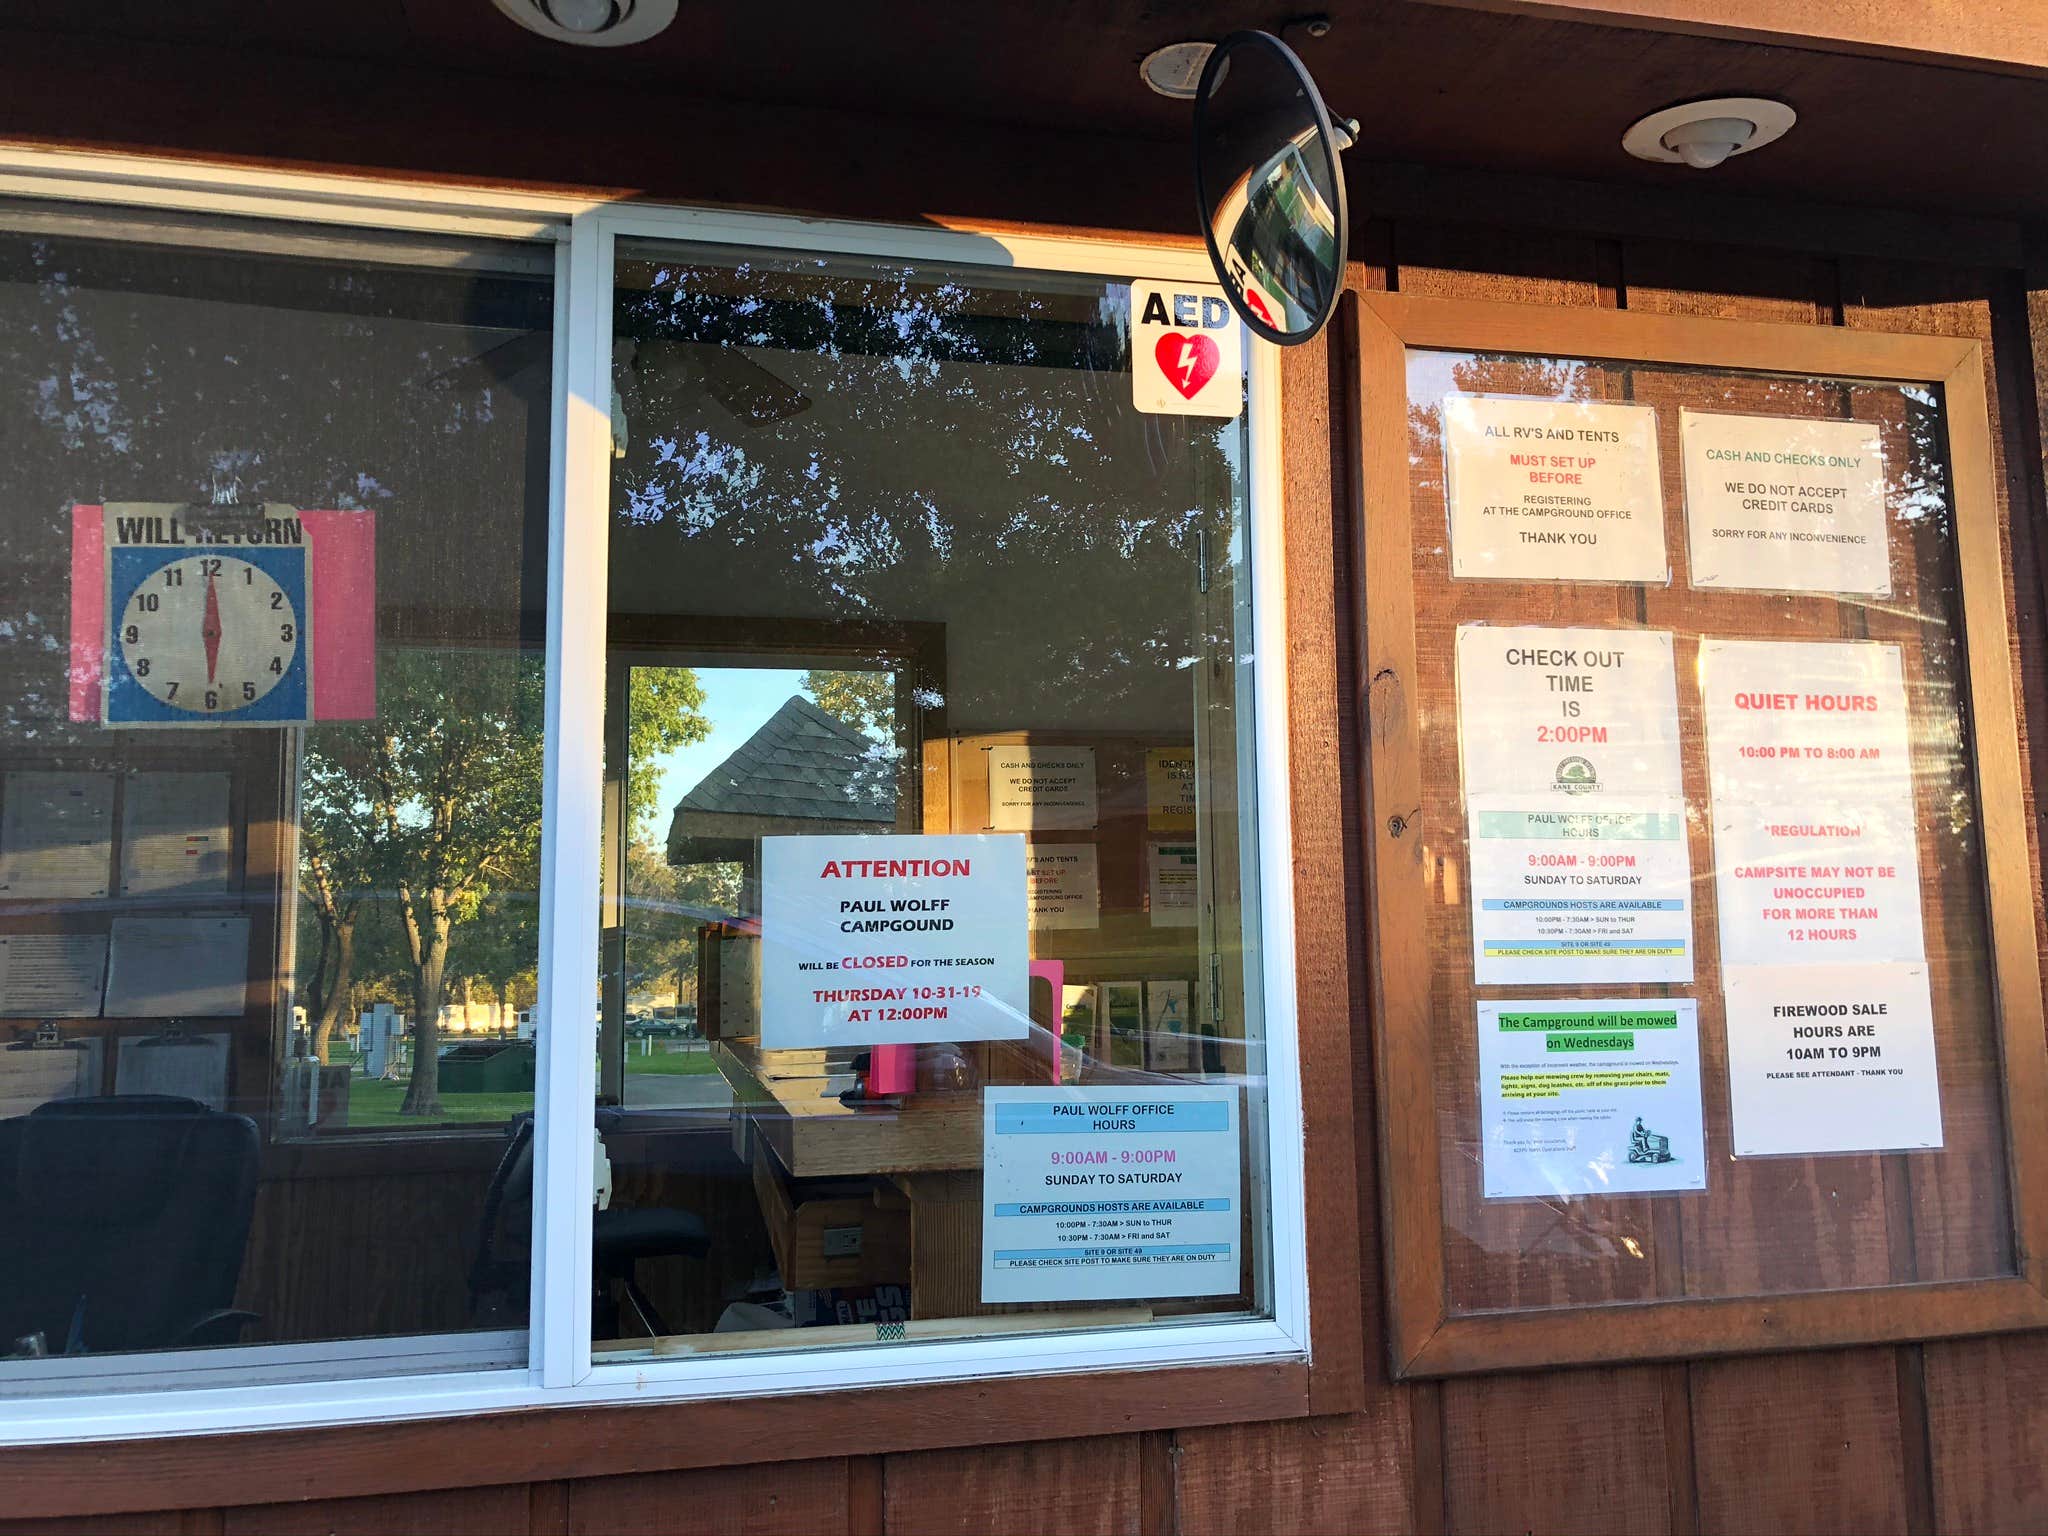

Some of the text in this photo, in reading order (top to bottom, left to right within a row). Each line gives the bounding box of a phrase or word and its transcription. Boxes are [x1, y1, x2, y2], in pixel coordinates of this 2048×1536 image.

[1141, 292, 1230, 329] AED
[1485, 425, 1619, 443] ALL RV'S AND TENTS
[1510, 454, 1596, 470] MUST SET UP
[1705, 449, 1861, 469] CASH AND CHECKS ONLY
[1529, 471, 1582, 485] BEFORE
[1725, 481, 1847, 499] WE DO NOT ACCEPT
[1523, 495, 1592, 506] REGISTERING
[1742, 498, 1833, 514] CREDIT CARDS
[1482, 506, 1632, 520] AT THE CAMPGROUND OFFICE
[116, 517, 185, 545] WILL
[1519, 531, 1597, 545] THANK YOU
[1711, 528, 1867, 545] SORRY FOR ANY INCONVENIENCE
[200, 559, 222, 577] 12
[164, 568, 183, 586] 11
[243, 568, 253, 585] 1
[135, 594, 159, 612] 10
[270, 592, 283, 610] 2
[125, 625, 139, 644] 9
[280, 623, 294, 643] 3
[269, 657, 283, 675] 4
[1506, 649, 1624, 668] CHECK OUT
[136, 658, 150, 677] 8
[166, 682, 180, 699] 7
[242, 682, 256, 701] 5
[1546, 675, 1594, 692] TIME
[205, 691, 217, 710] 6
[1734, 693, 1878, 712] QUIET HOURS
[1562, 701, 1581, 717] IS
[1537, 726, 1608, 743] 2:00PM
[1738, 747, 1880, 759] 10:00 PM TO 8:00 AM
[820, 859, 970, 878] ATTENTION
[1528, 855, 1636, 867] 9:00AM 9:00PM
[1524, 875, 1642, 885] SUNDAY TO SATURDAY
[1734, 866, 1896, 878] CAMPSITE MAY NOT BE
[1773, 887, 1865, 899] UNOCCUPIED
[840, 899, 950, 913] PAUL WOLFF
[1503, 901, 1662, 909] CAMPGROUNDS HOSTS ARE AVAILABLE
[1762, 908, 1878, 920] FOR MORE THAN
[840, 919, 954, 933] CAMPGOUND
[1787, 928, 1856, 941] 12 HOURS
[798, 955, 995, 971] WILL BE CLOSED FOR THE SEASON
[813, 986, 982, 1003] THURSDAY 10-31-19
[847, 1007, 948, 1022] AT 12:00PM
[1773, 1004, 1887, 1017] FIREWOOD SALE
[1499, 1013, 1677, 1030] The Campground will be mowed
[1793, 1025, 1875, 1038] HOURS ARE
[1546, 1037, 1634, 1050] on Wednesdays
[1786, 1046, 1881, 1060] 10AM TO 9PM
[1811, 1070, 1855, 1078] ATTENDANT
[1053, 1104, 1175, 1116] PAUL WOLFF OFFICE
[1093, 1119, 1136, 1131] HOURS
[1051, 1150, 1176, 1165] 9:00AM 9:00PM
[1045, 1172, 1183, 1186] SUNDAY TO SATURDAY
[1019, 1201, 1205, 1214] CAMPGROUNDS HOSTS ARE AVAILABLE
[1125, 1219, 1142, 1227] SUN
[1143, 1219, 1150, 1227] to
[1151, 1219, 1172, 1227] THUR
[1127, 1232, 1140, 1240] FRI
[1140, 1232, 1155, 1240] and
[1155, 1231, 1170, 1240] SAT
[1009, 1259, 1038, 1267] PLEASE
[1064, 1258, 1081, 1266] SITE
[1081, 1257, 1100, 1265] POST
[1132, 1256, 1151, 1264] SURE
[1152, 1255, 1170, 1263] THEY
[1197, 1254, 1215, 1262] DUTY
